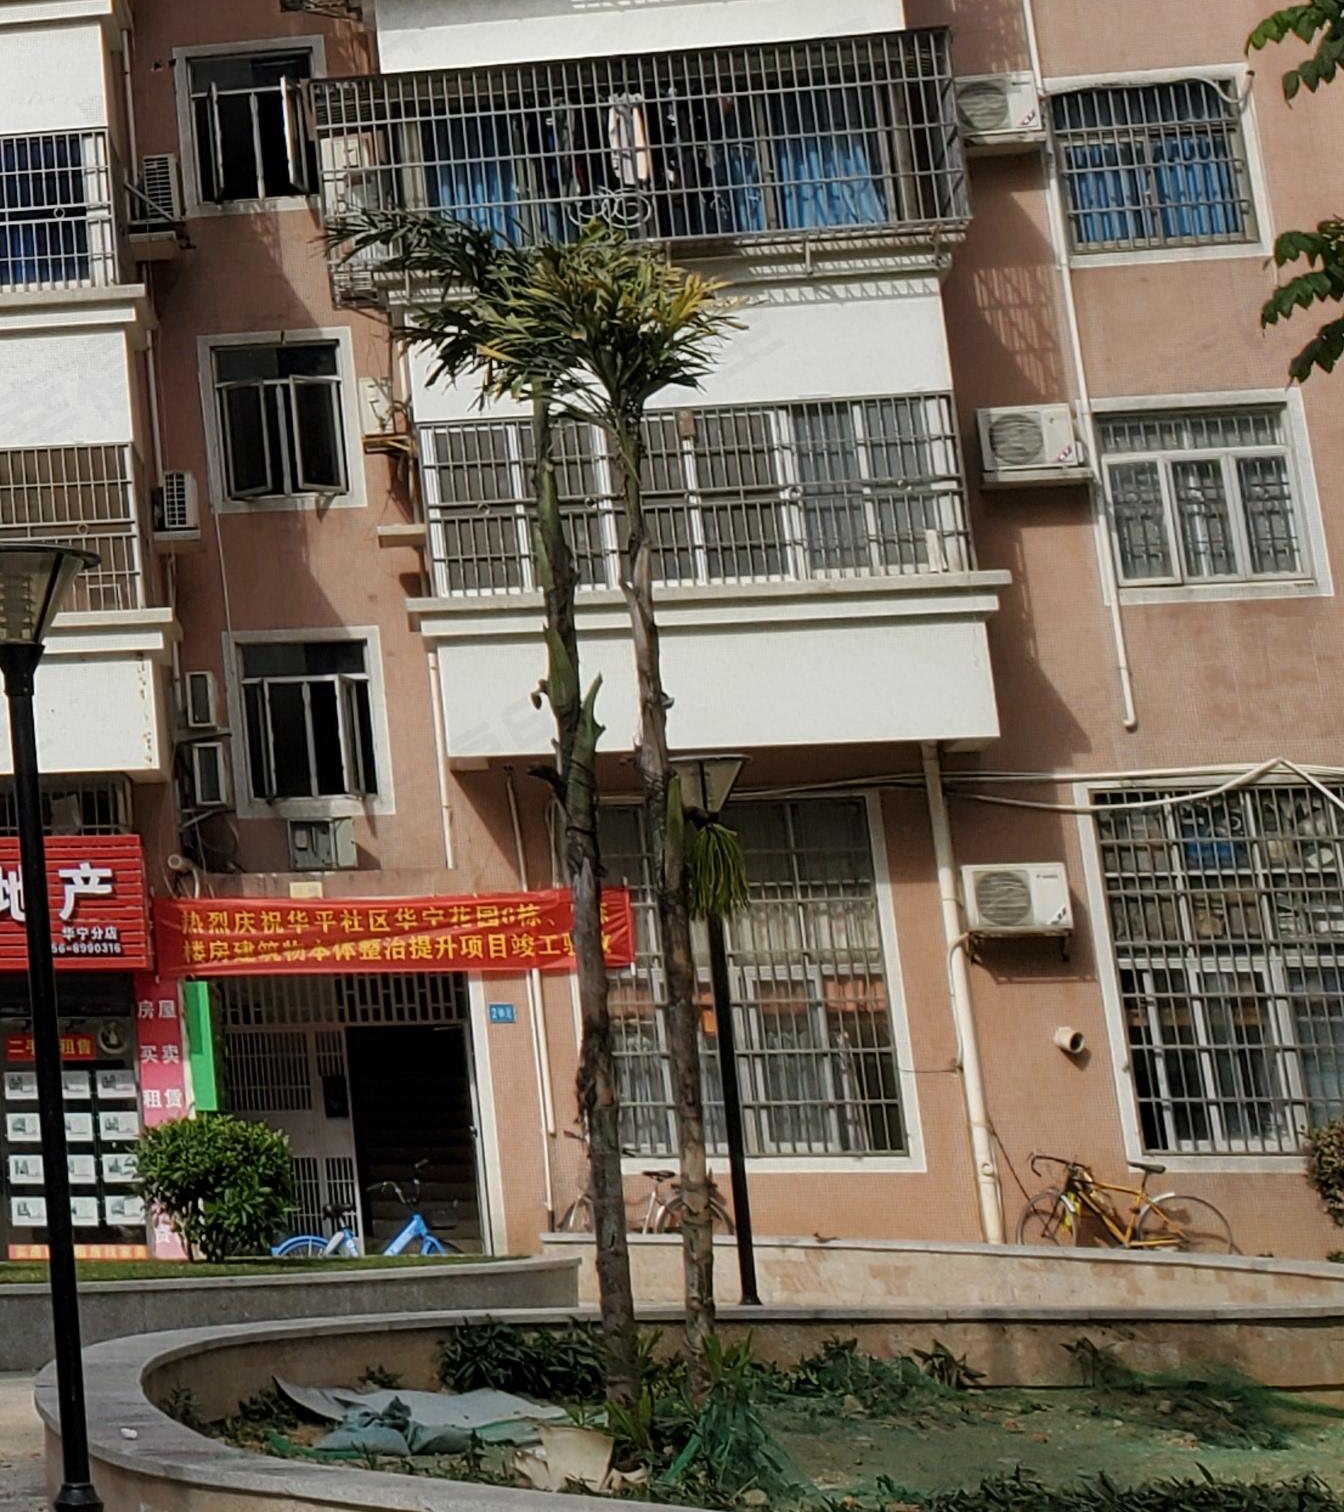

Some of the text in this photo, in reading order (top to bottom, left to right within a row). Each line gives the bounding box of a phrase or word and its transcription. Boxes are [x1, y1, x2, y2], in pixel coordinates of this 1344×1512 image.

[180, 902, 609, 935] 热烈庆祝华平社区华宁花园6栋、
[61, 926, 118, 941] 华宁分店
[137, 999, 177, 1020] 房屋
[140, 1044, 180, 1065] 买卖
[143, 1088, 183, 1109] 租赁
